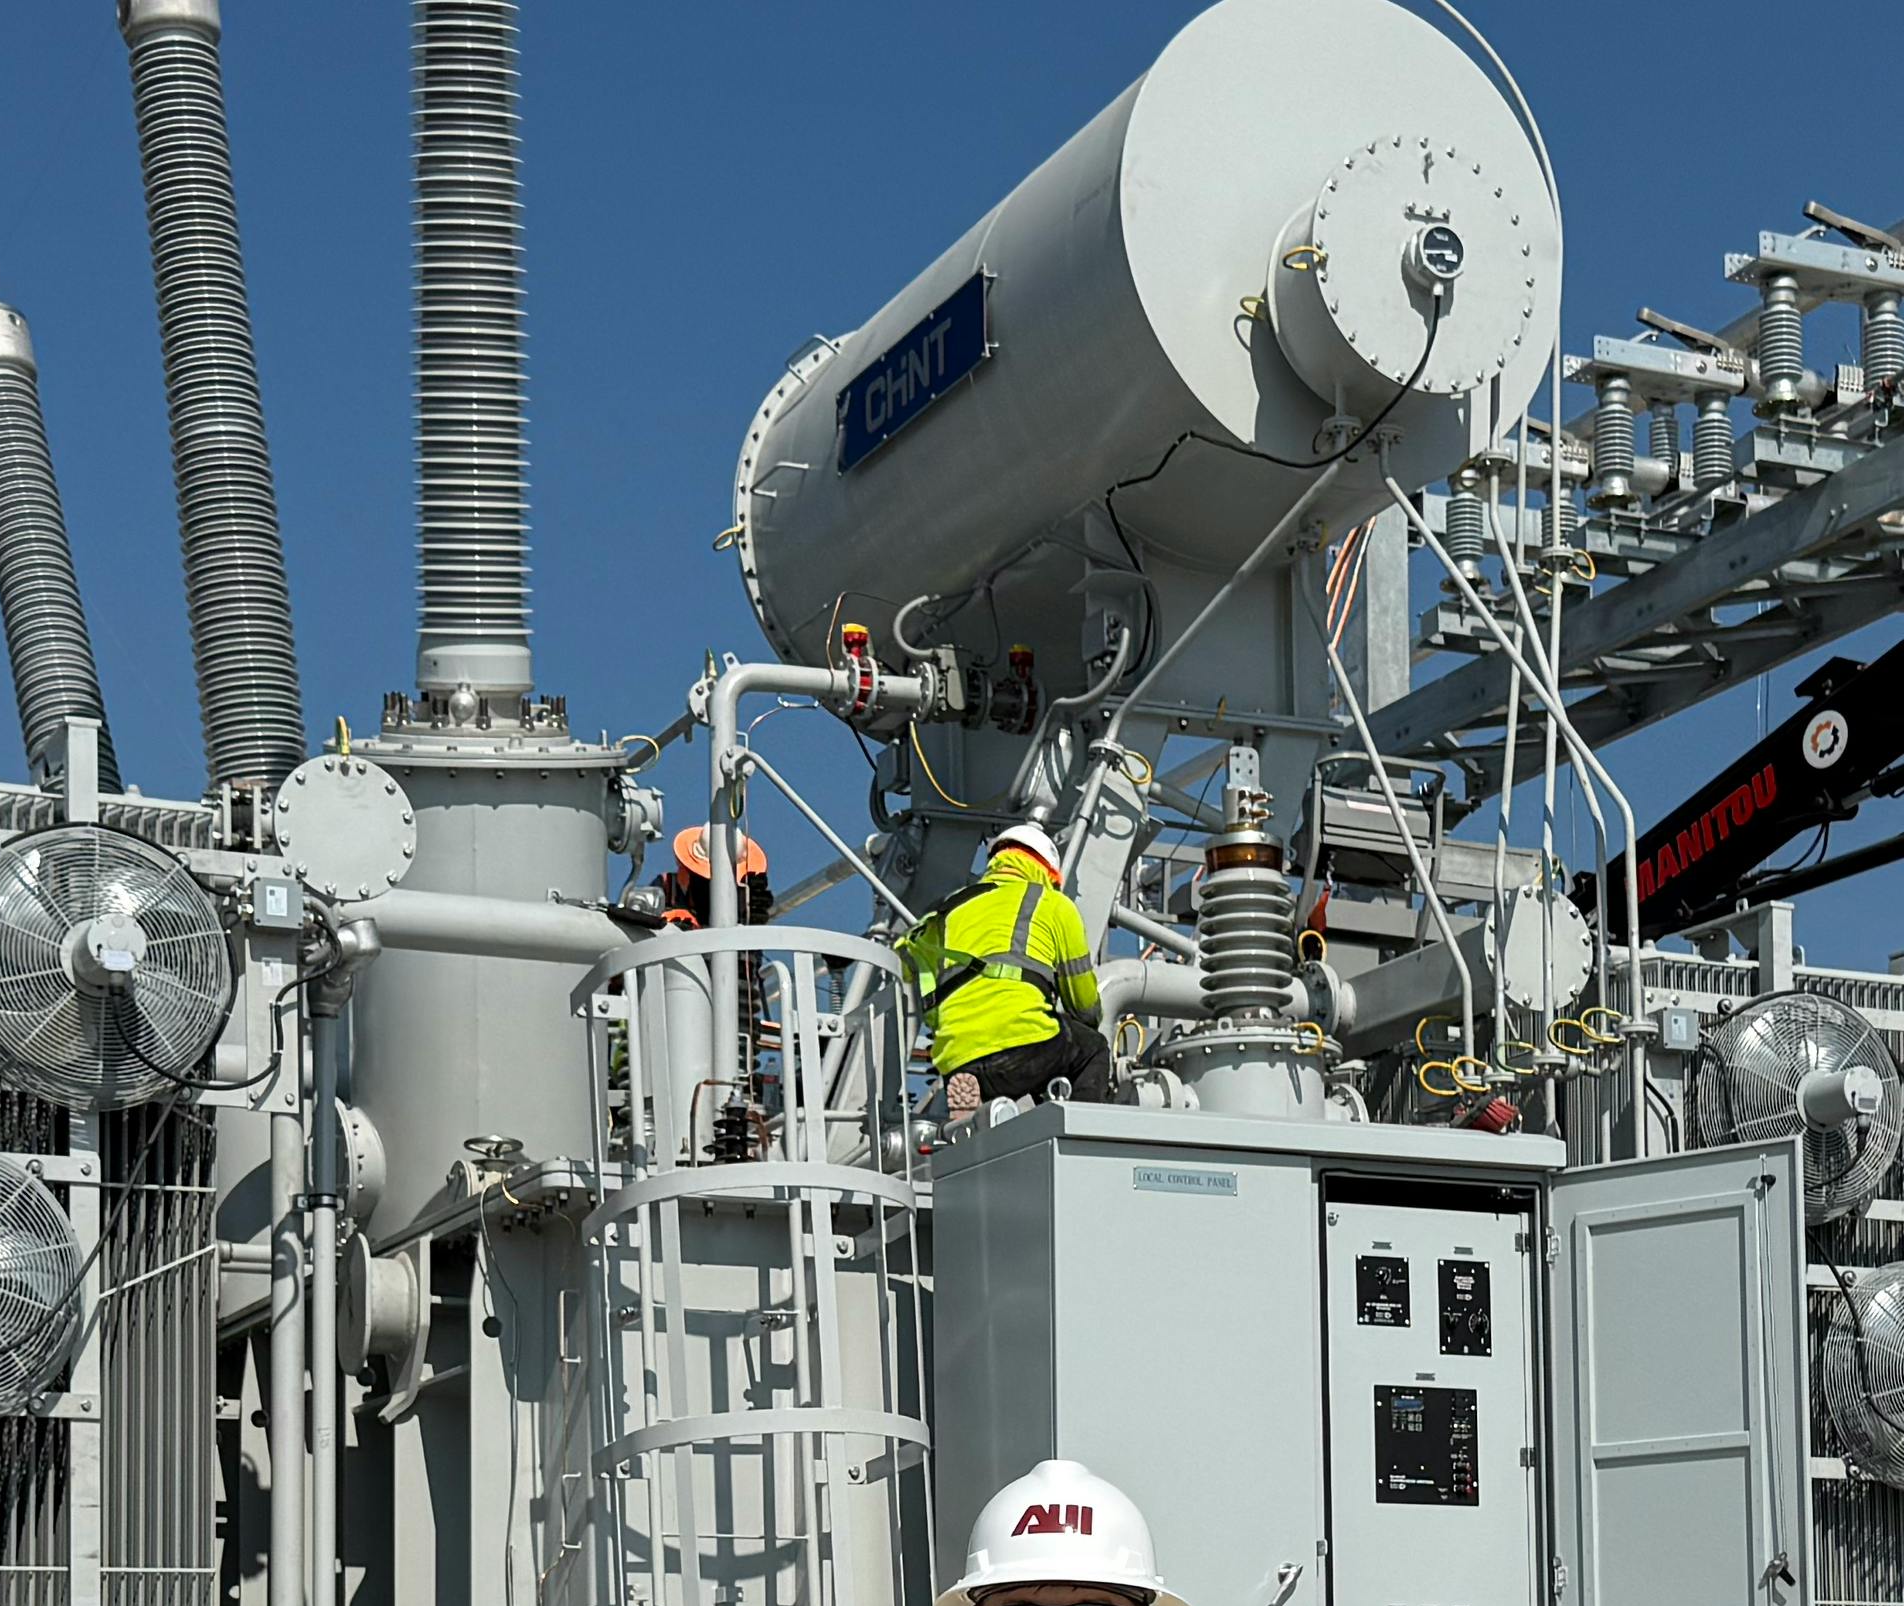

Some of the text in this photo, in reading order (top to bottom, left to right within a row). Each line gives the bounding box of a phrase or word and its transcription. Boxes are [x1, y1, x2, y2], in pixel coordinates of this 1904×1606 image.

[1624, 763, 1777, 903] MANITOU
[1138, 1172, 1233, 1189] LOCAL CONTROL PANEL
